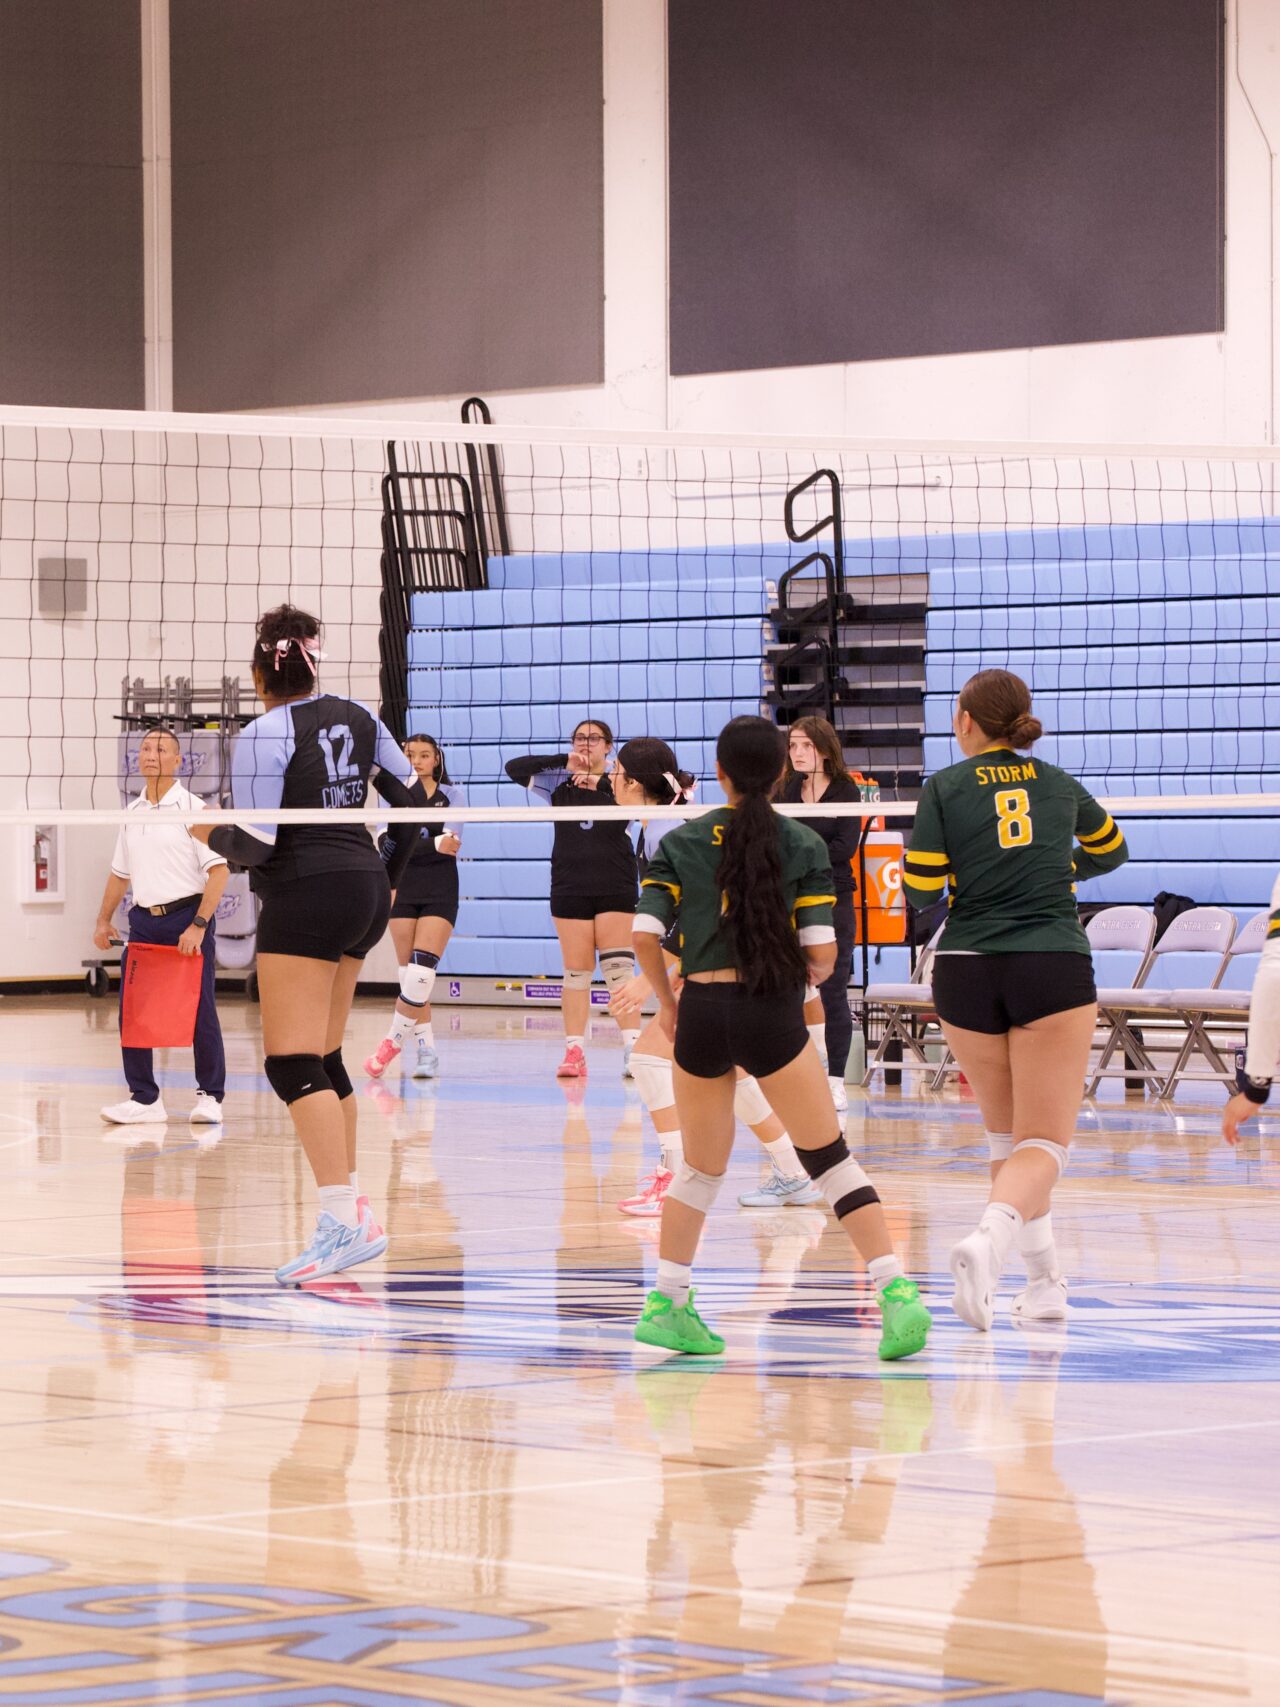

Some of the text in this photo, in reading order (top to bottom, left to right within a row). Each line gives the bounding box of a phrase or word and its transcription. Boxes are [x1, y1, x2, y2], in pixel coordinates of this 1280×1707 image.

[317, 724, 360, 783] 12
[975, 762, 1038, 785] STORM
[322, 779, 364, 809] COMETS
[994, 788, 1033, 849] 8
[882, 861, 901, 890] G
